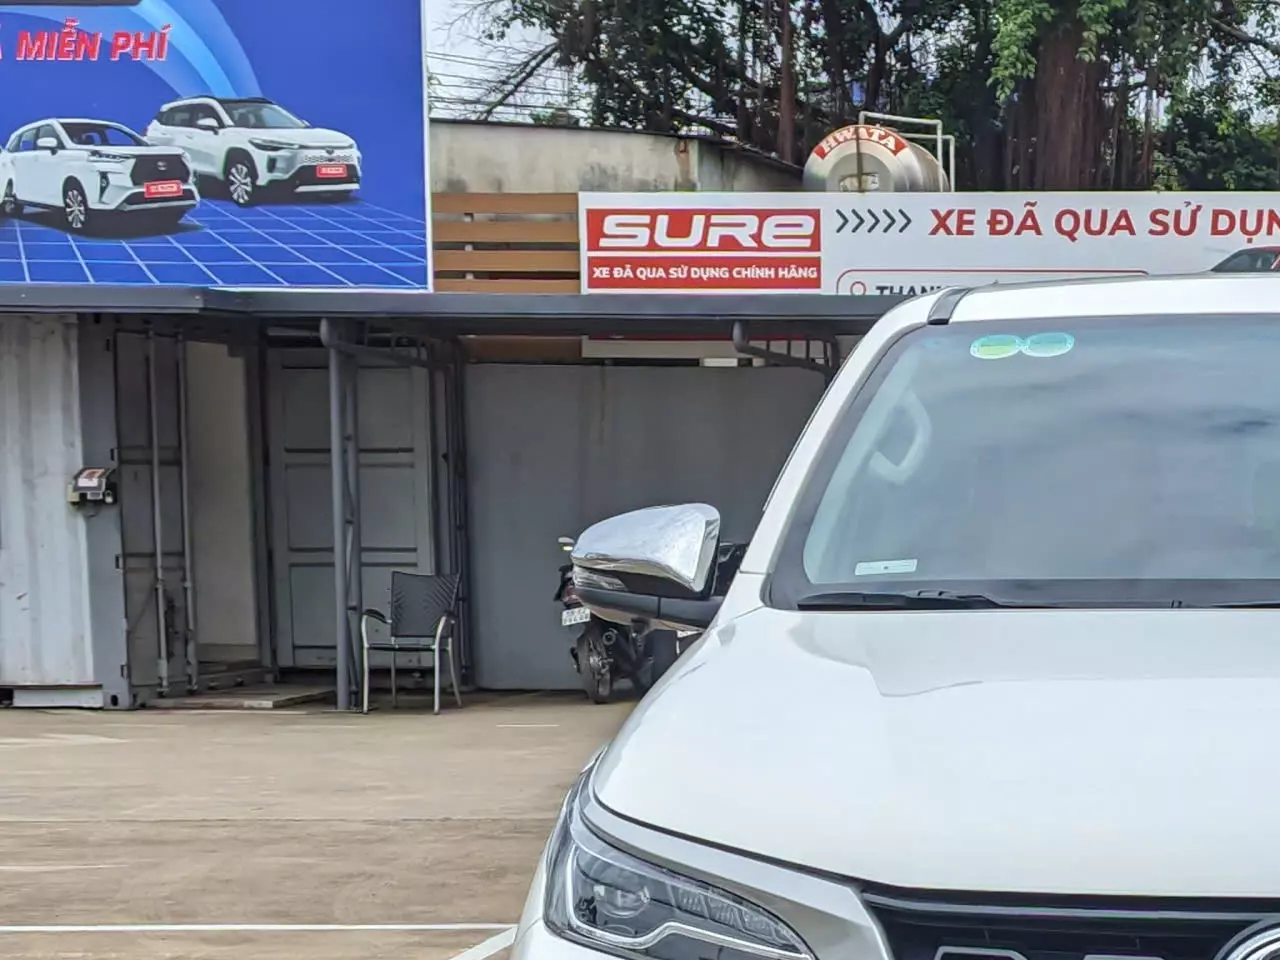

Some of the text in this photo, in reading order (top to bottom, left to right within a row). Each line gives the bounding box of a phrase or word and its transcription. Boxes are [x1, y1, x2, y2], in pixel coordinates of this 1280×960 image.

[16, 17, 102, 61] MIỄN
[110, 23, 173, 61] PHÍ
[928, 208, 976, 236] XE
[986, 201, 1043, 236] ĐÃ
[1054, 208, 1137, 242] QUA
[1147, 201, 1203, 237] SỬ
[592, 267, 610, 278] XE
[613, 264, 632, 277] ĐÃ
[636, 267, 666, 280] QUA
[691, 267, 729, 281] DỤNG
[732, 264, 775, 278] CHÍNH
